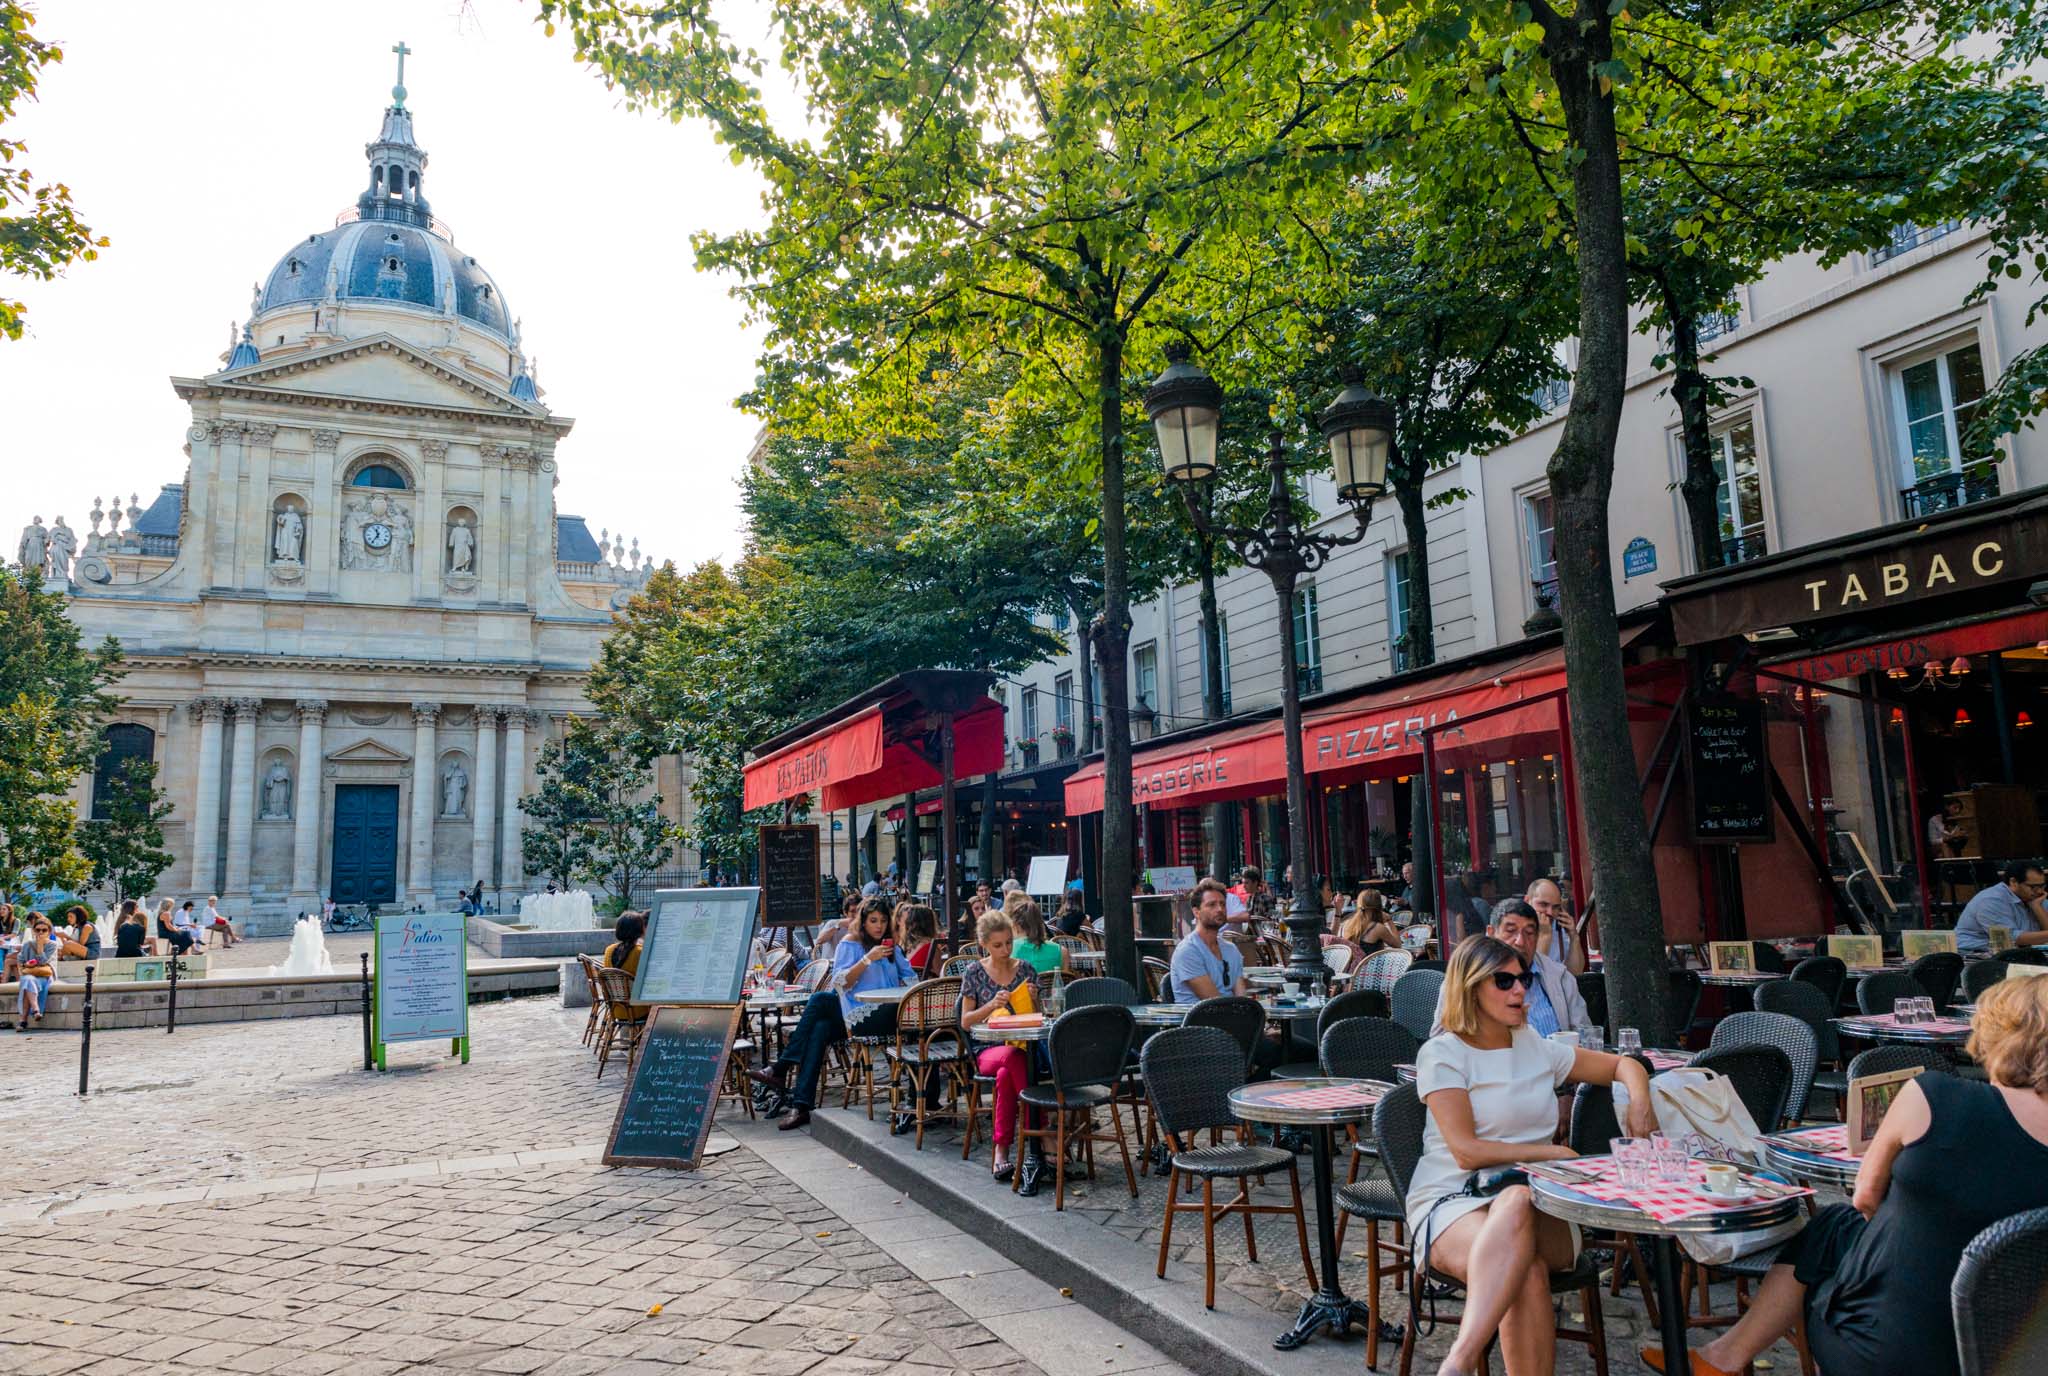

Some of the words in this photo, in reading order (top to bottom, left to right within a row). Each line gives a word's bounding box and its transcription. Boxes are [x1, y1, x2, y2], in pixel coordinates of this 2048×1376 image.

[1804, 541, 2004, 612] TABAC
[1796, 658, 1835, 681] LES
[1845, 640, 1930, 674] PATIOS
[1317, 708, 1465, 764] PIZZERIA
[777, 761, 792, 794] LES
[794, 745, 828, 787] PATIOS
[1132, 757, 1228, 796] RASSERIE
[403, 918, 422, 931] Les
[403, 928, 443, 946] Patios
